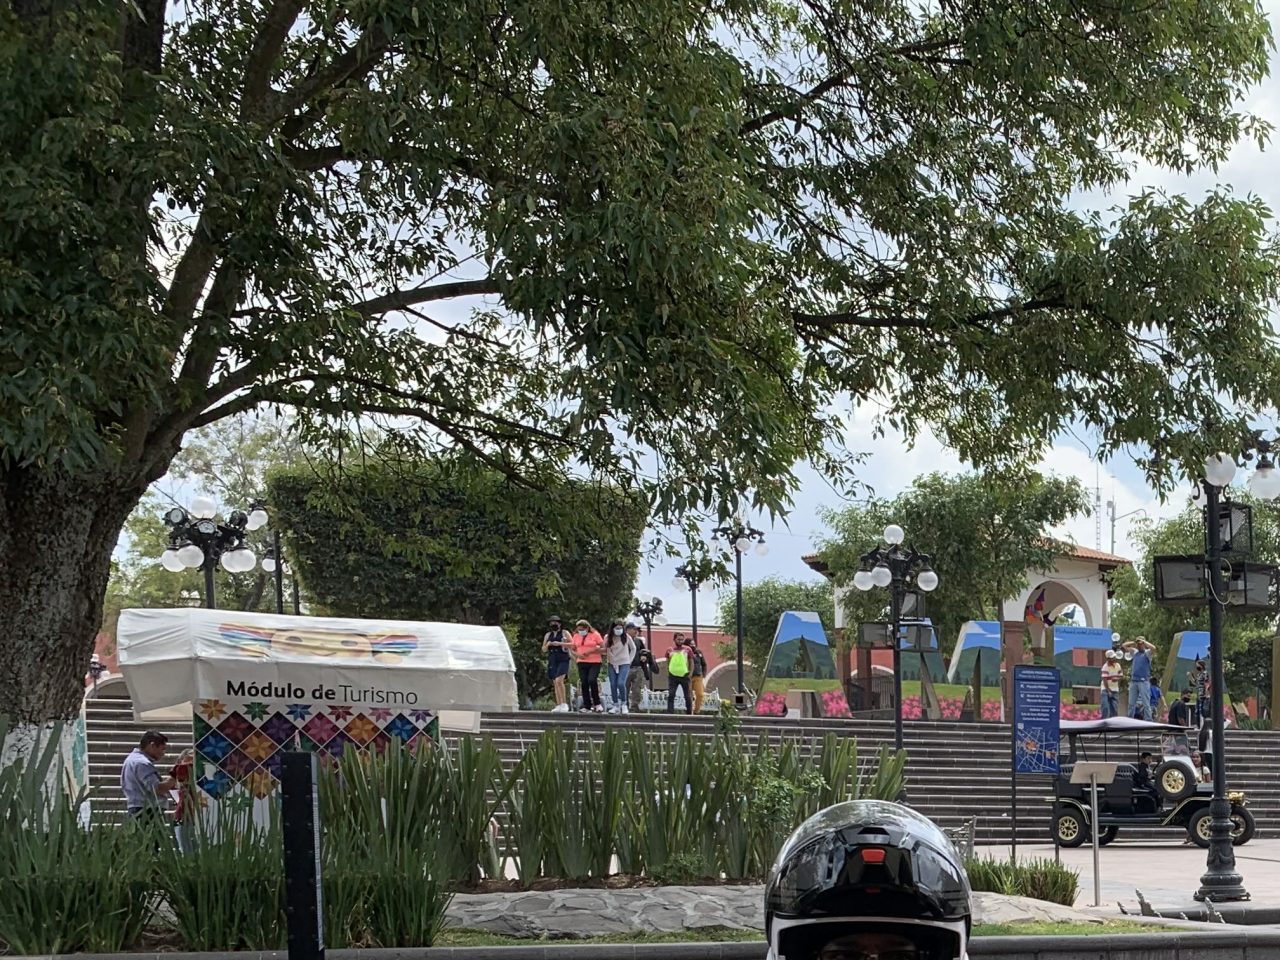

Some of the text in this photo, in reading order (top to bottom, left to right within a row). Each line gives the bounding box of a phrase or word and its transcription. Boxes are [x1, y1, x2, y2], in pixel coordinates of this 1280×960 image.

[226, 680, 418, 704] Módulo de Turismo
